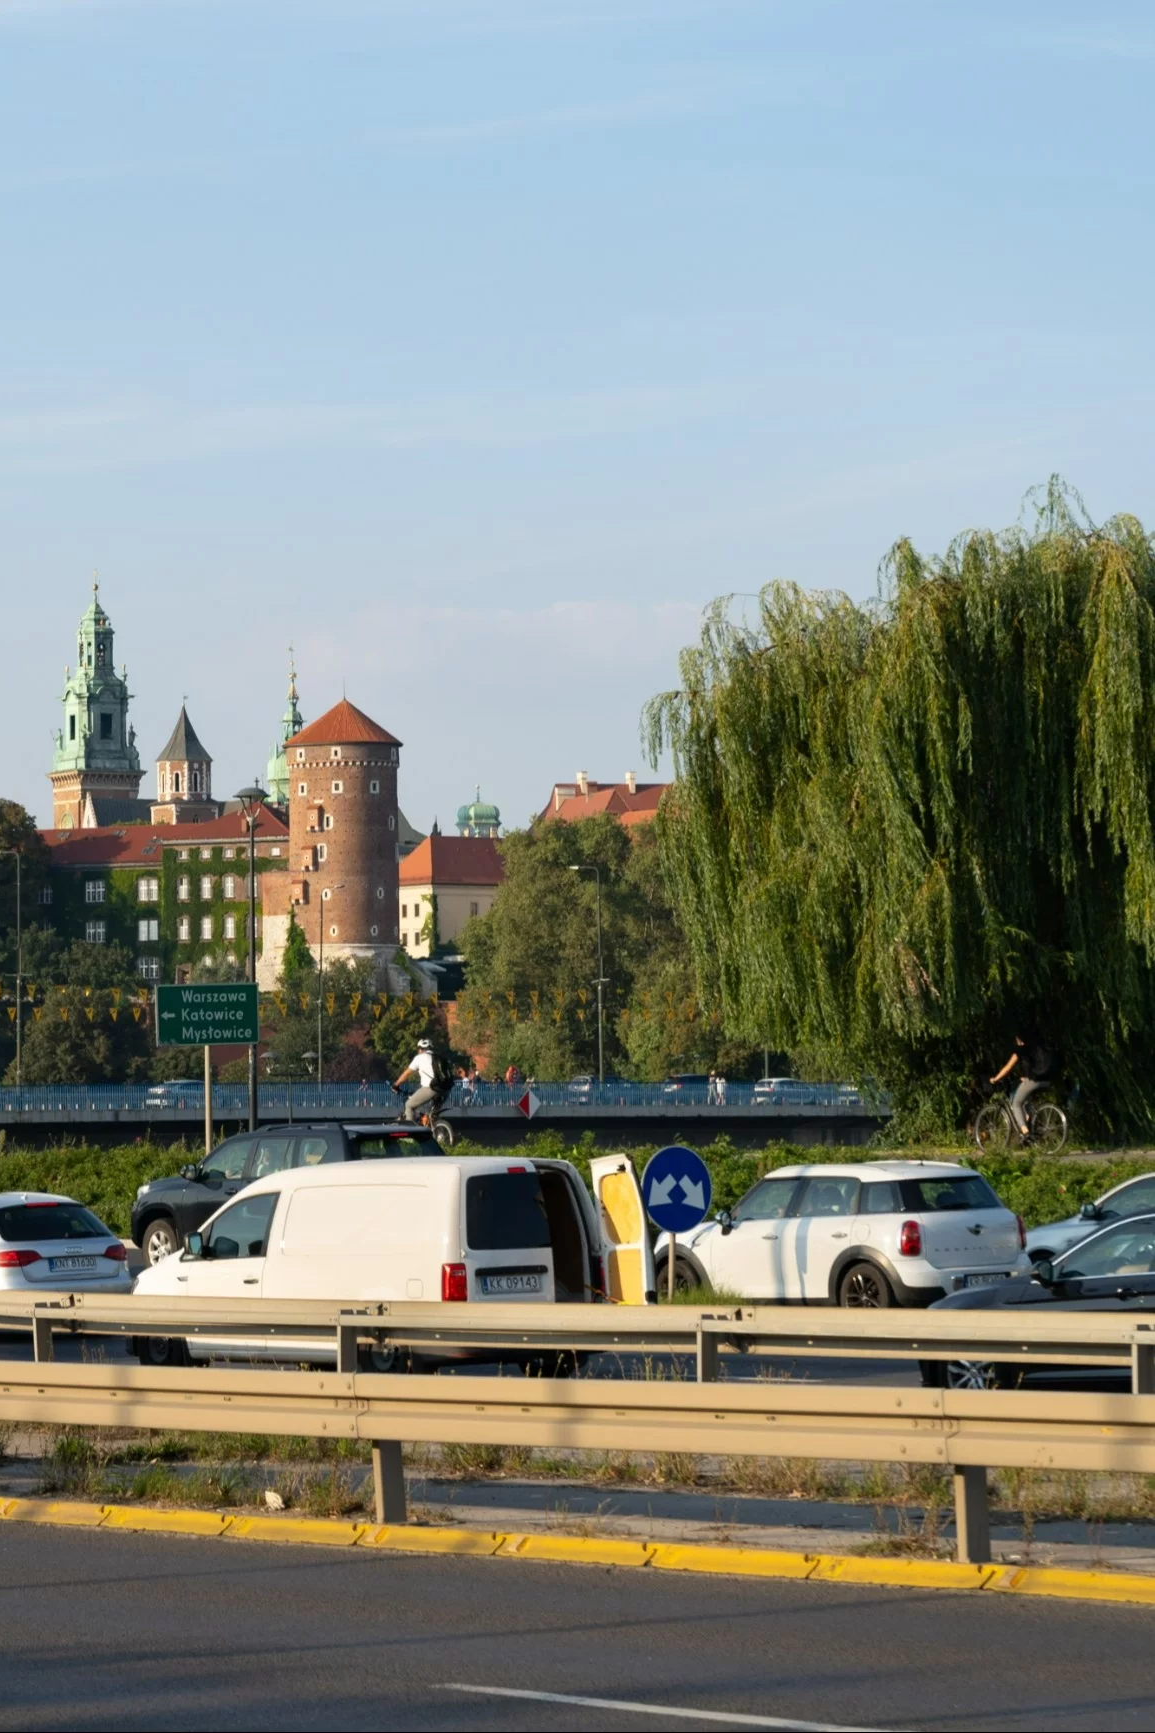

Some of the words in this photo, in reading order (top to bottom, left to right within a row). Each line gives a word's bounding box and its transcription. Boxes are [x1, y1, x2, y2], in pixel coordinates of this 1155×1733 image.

[181, 989, 247, 1003] Warszawa
[181, 1007, 244, 1021] Katowice
[182, 1025, 253, 1043] Mysłowice
[489, 1277, 503, 1290] KK
[506, 1276, 538, 1289] 09143
